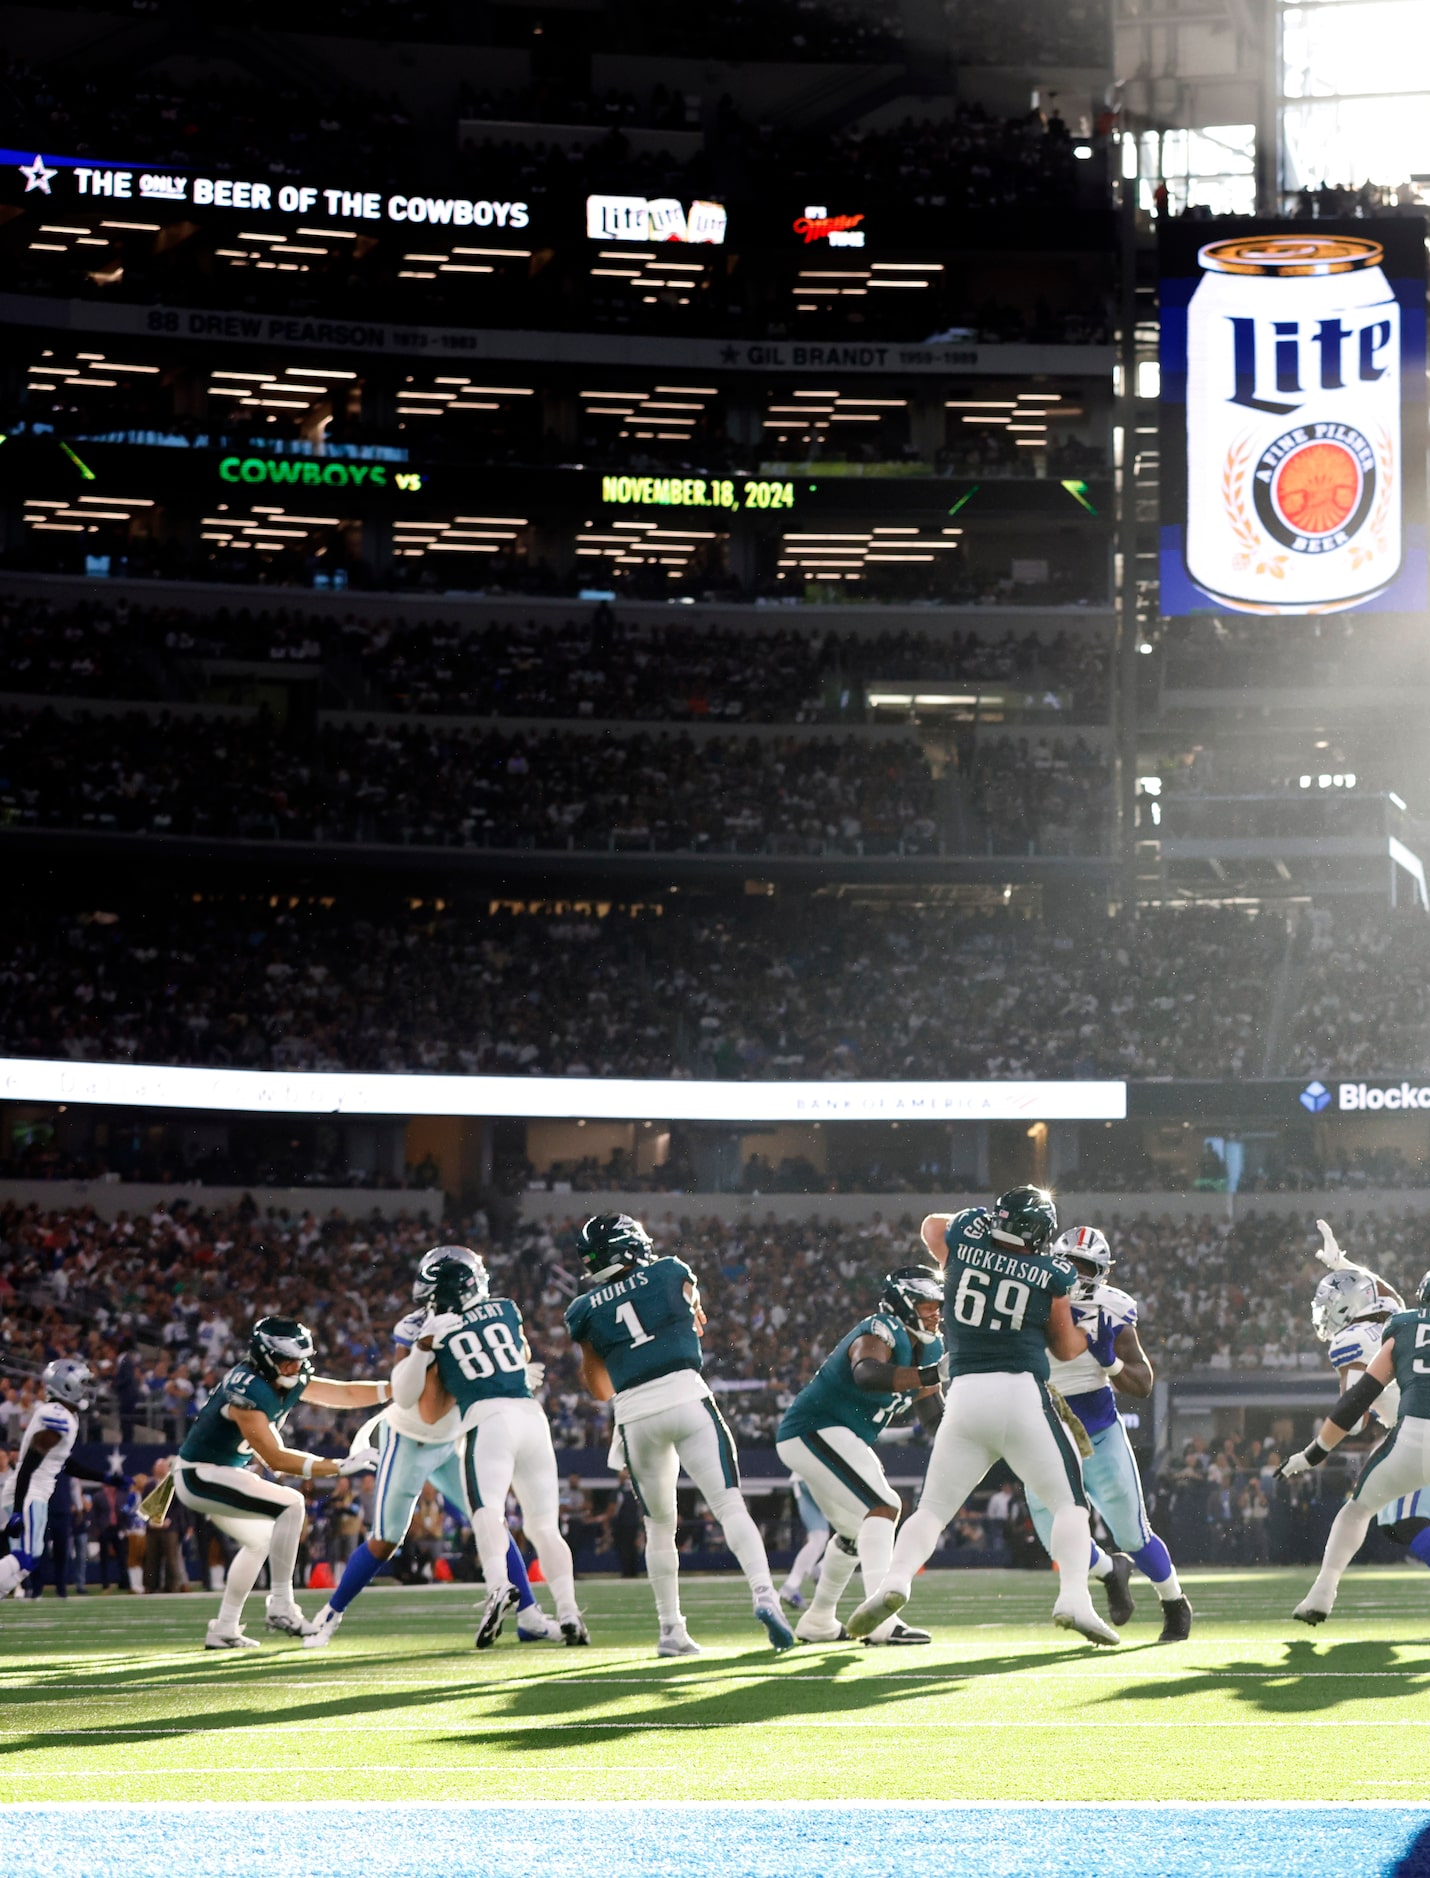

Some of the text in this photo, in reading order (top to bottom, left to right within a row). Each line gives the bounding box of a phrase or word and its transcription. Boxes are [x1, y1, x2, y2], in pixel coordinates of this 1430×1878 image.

[74, 167, 529, 228] THE ONLY BEER OF THE COWBOYS
[148, 311, 179, 333] 88
[189, 314, 261, 339] DREW
[269, 320, 384, 348] PEARSON
[747, 346, 784, 366] GIL
[793, 347, 889, 367] BRANDT
[1222, 314, 1394, 416] Lite
[1262, 427, 1310, 467] FINE
[218, 456, 388, 487] COWBOYS
[1256, 469, 1273, 484] A
[744, 480, 795, 509] 2024
[1290, 530, 1350, 553] BEER
[956, 1243, 1053, 1290] DICKERSON
[589, 1271, 649, 1309] HURTS
[953, 1267, 1030, 1332] 69
[462, 1302, 505, 1326] DERT
[615, 1301, 656, 1350] 1
[448, 1322, 524, 1381] 88
